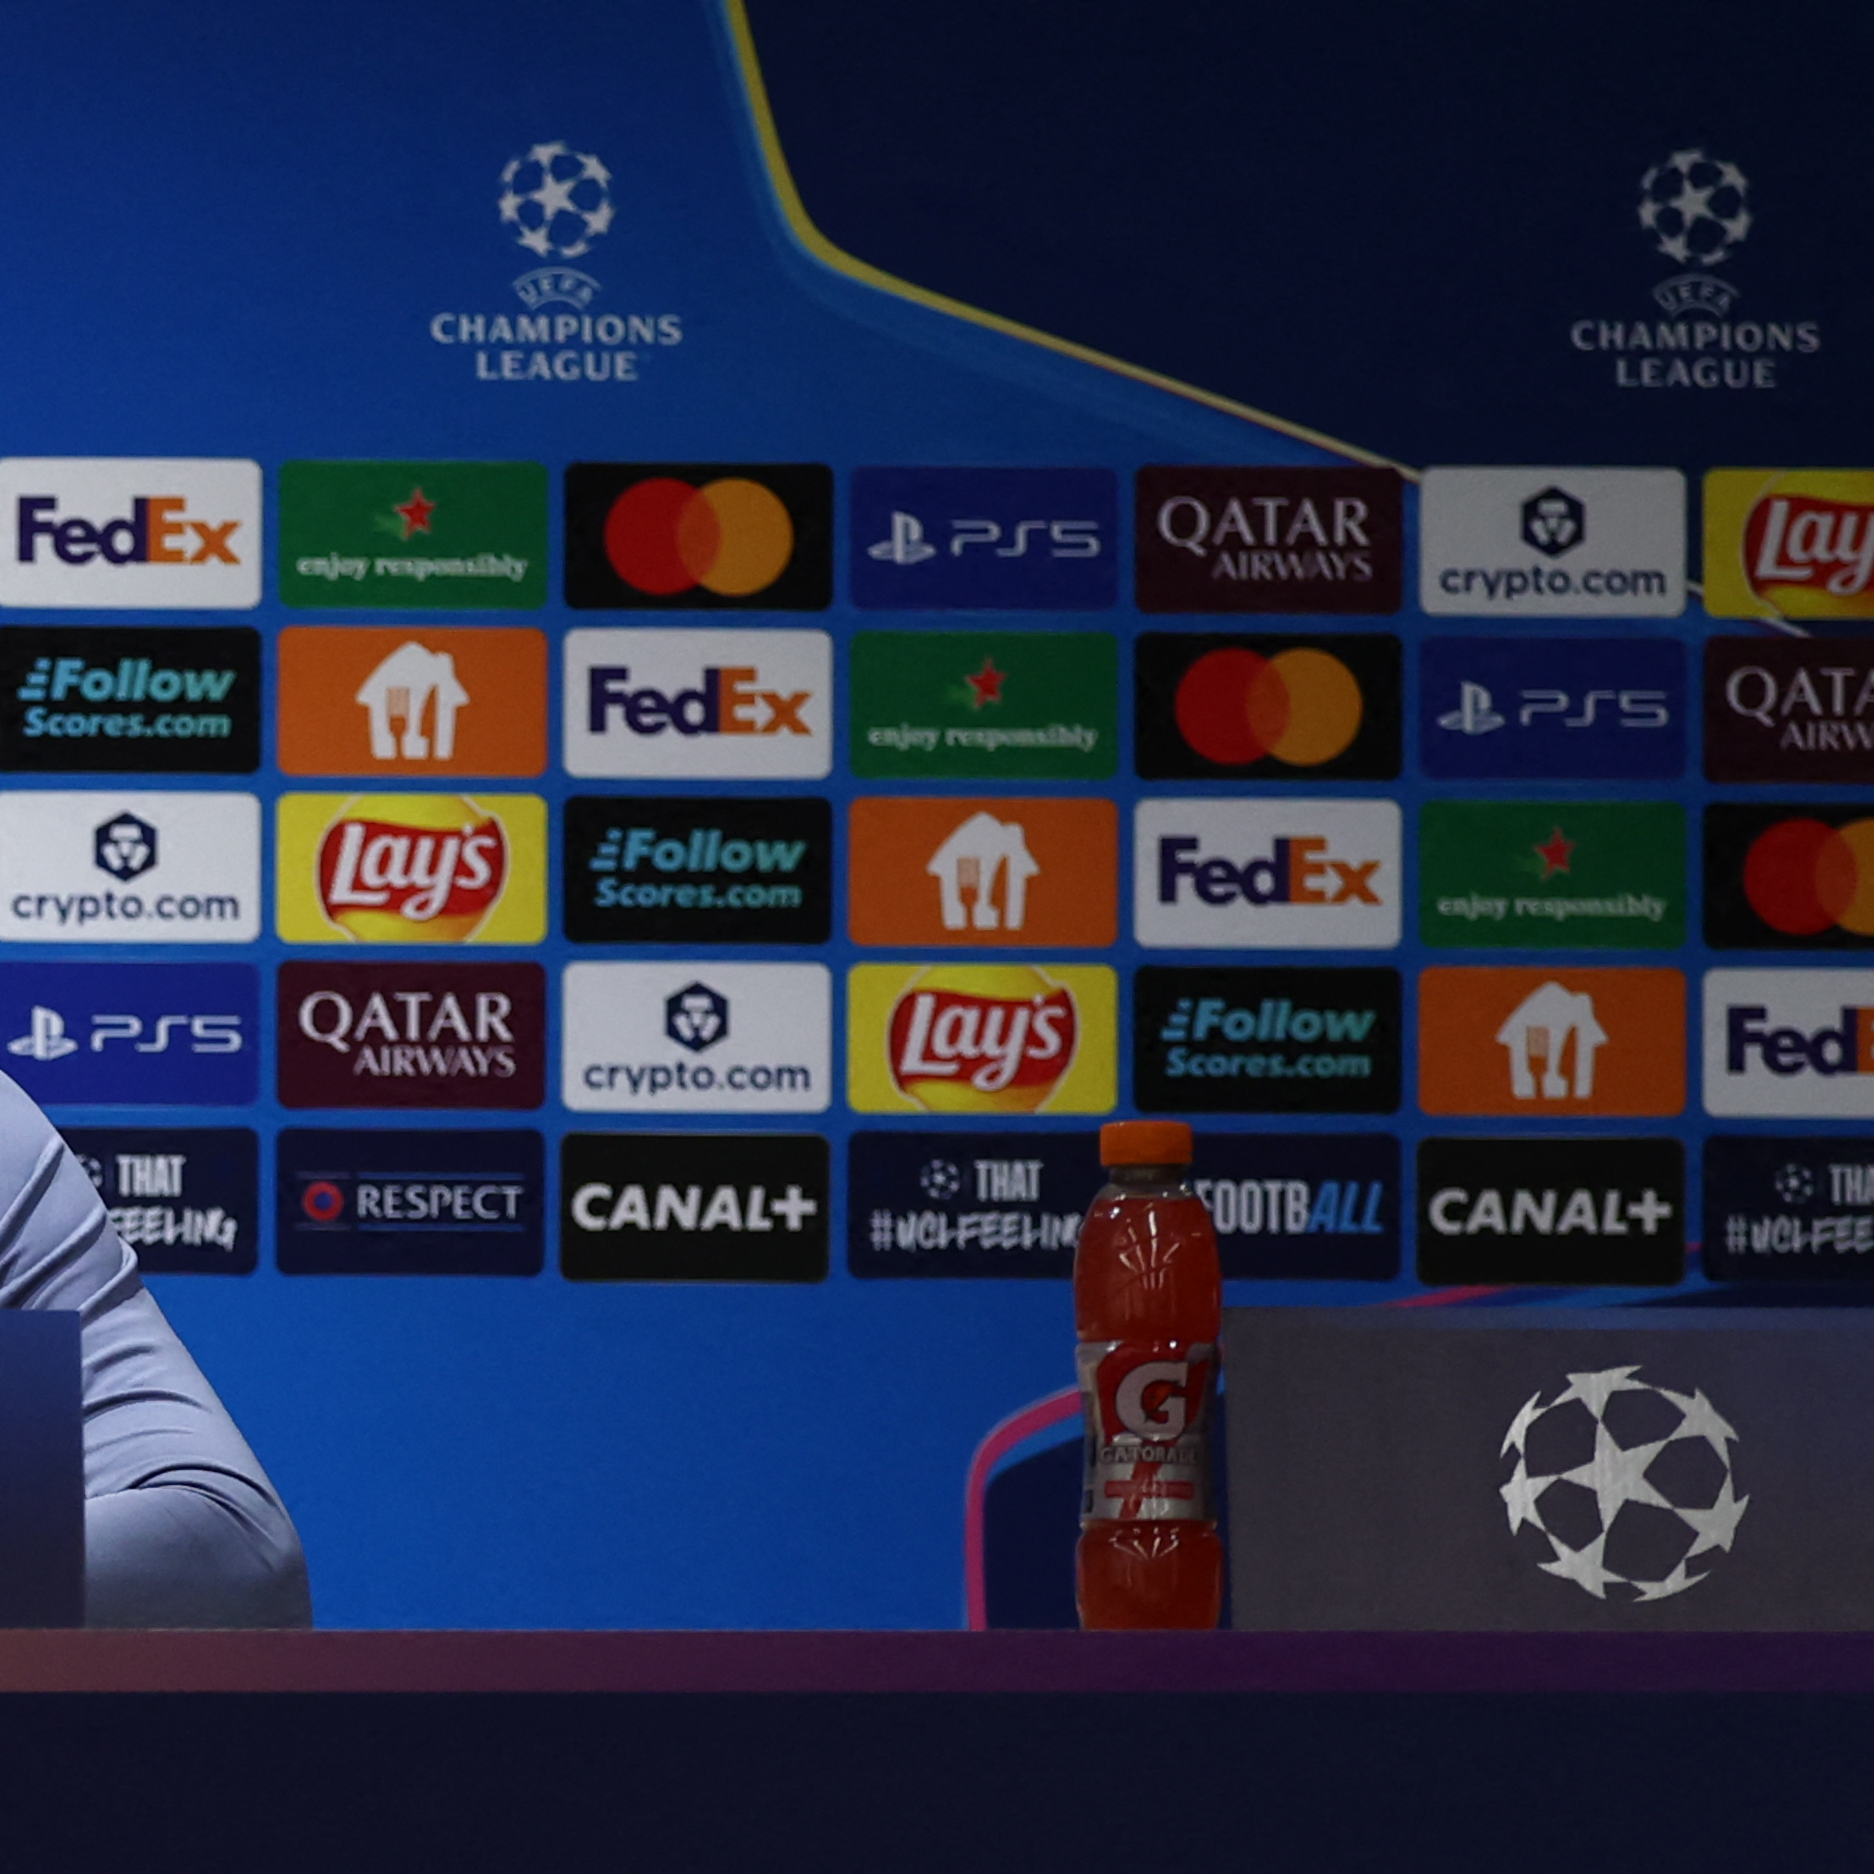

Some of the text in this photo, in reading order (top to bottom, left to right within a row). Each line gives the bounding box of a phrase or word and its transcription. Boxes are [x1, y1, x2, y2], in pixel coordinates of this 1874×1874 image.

[518, 274, 594, 304] UEFA
[1654, 281, 1735, 311] UEFA
[430, 313, 683, 346] CHAMPIONS
[1570, 320, 1821, 352] CHAMPIONS
[476, 350, 638, 381] LEAGUE
[1616, 358, 1776, 388] LEAGUE
[17, 495, 241, 566] FedEx
[950, 520, 1101, 558] PS5
[1158, 497, 1369, 556] QATAR
[1214, 551, 1372, 580] AIRWAYS
[1755, 498, 1874, 596] Lay
[296, 552, 528, 582] enjoy responsibly
[1439, 564, 1667, 600] crypto.com
[50, 658, 234, 702] Follow
[588, 666, 811, 737] FedEx
[1519, 690, 1669, 728] PS5
[23, 706, 231, 737] Scores.com
[867, 723, 1097, 752] enjoy responsibly
[1779, 721, 1874, 751] AIRW
[622, 828, 805, 872] Follow
[332, 826, 501, 922] Lay's
[1158, 835, 1381, 907] FedEx
[11, 890, 240, 925] crypto.com
[594, 877, 801, 908] Scores.com
[1436, 894, 1666, 922] enjoy responsibly
[91, 1015, 243, 1053] PS5
[299, 992, 512, 1060] QATAR
[1192, 998, 1375, 1042] Follow
[905, 994, 1074, 1090] Lay's
[1729, 1007, 1874, 1073] Fed
[355, 1046, 516, 1076] AIRWAYS
[583, 1060, 812, 1096] crypto.com
[1165, 1046, 1371, 1077] Scores.com
[116, 1155, 187, 1197] THAT
[975, 1159, 1043, 1202] THAT
[1828, 1164, 1874, 1206] THA
[357, 1185, 522, 1219] RESPECT
[571, 1183, 816, 1231] CANAL+
[1428, 1188, 1672, 1235] CANAL+
[869, 1210, 1082, 1251] #UCLFEELIN
[1725, 1212, 1874, 1258] #UCLFEE
[1116, 1361, 1188, 1440] G
